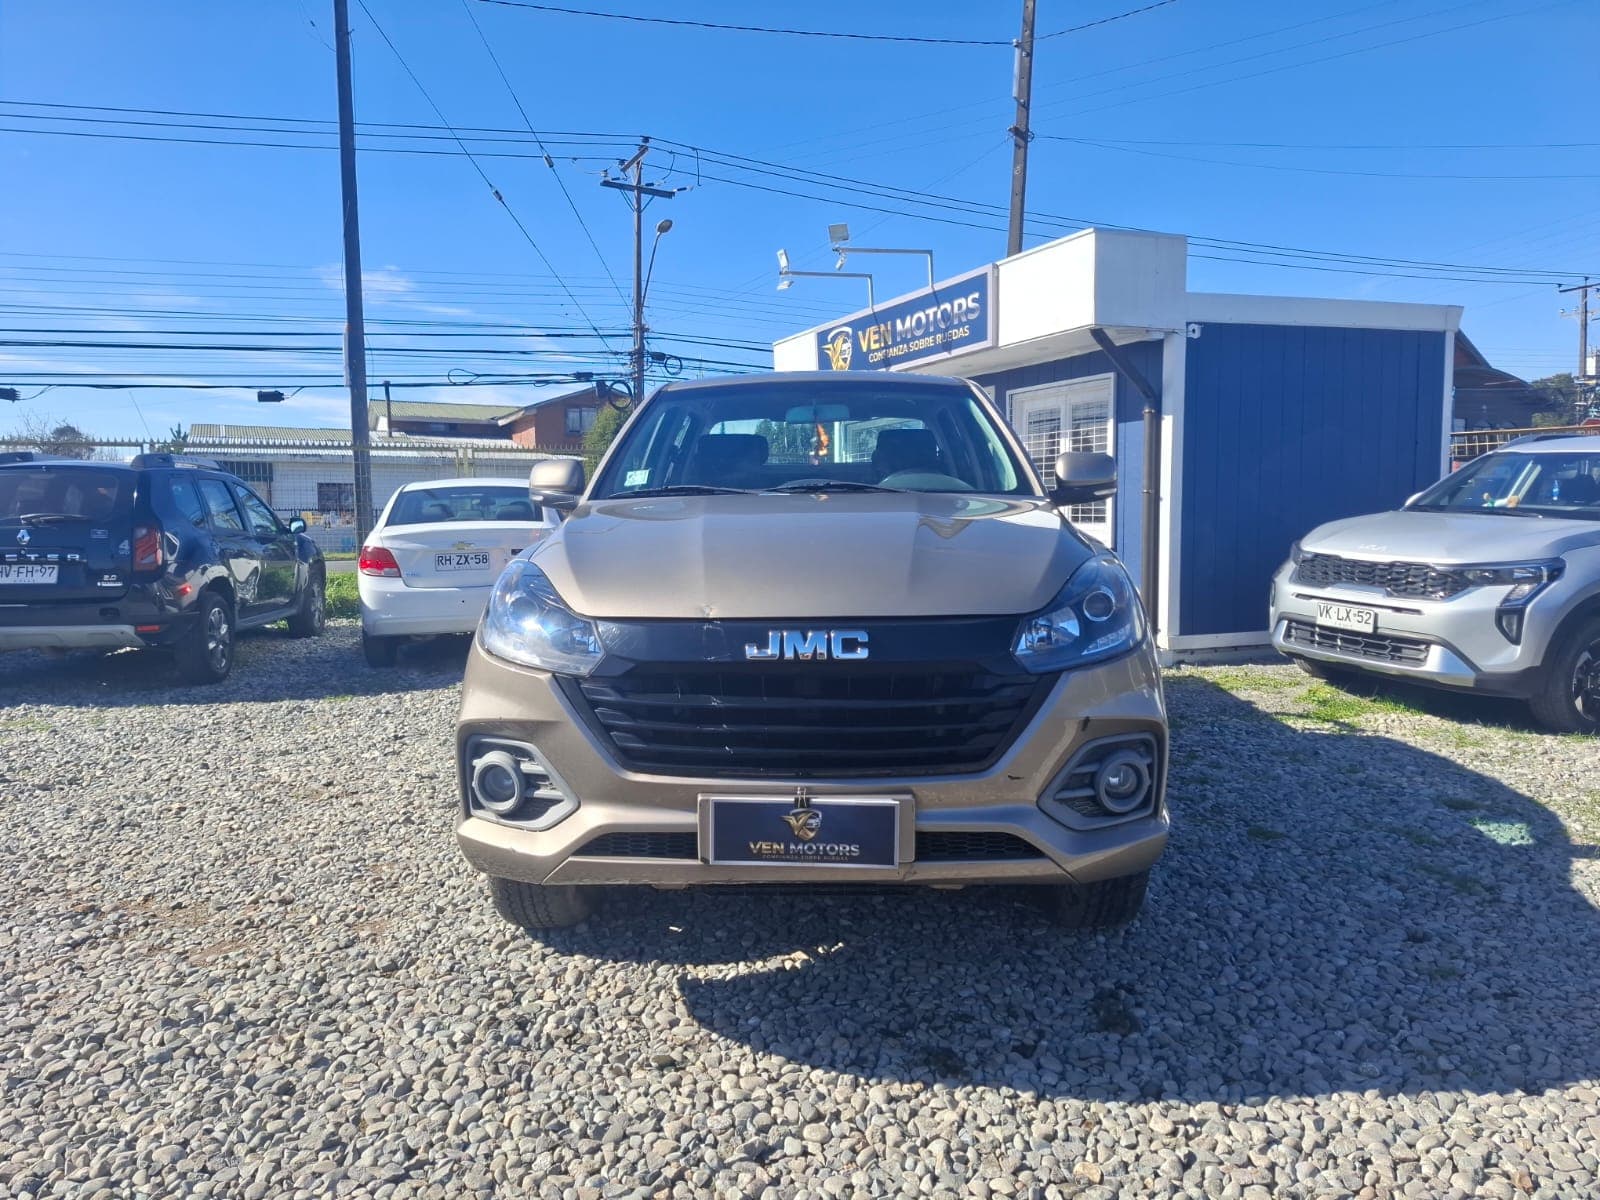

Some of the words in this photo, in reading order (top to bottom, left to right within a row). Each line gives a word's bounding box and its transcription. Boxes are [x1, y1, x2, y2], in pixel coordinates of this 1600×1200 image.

[858, 320, 892, 353] VEN
[896, 291, 981, 342] MOTORS
[909, 336, 935, 352] SOBRE
[936, 325, 970, 345] RUEDAS
[745, 630, 869, 660] JMC
[749, 841, 785, 855] VEN
[789, 842, 860, 857] MOTORS
